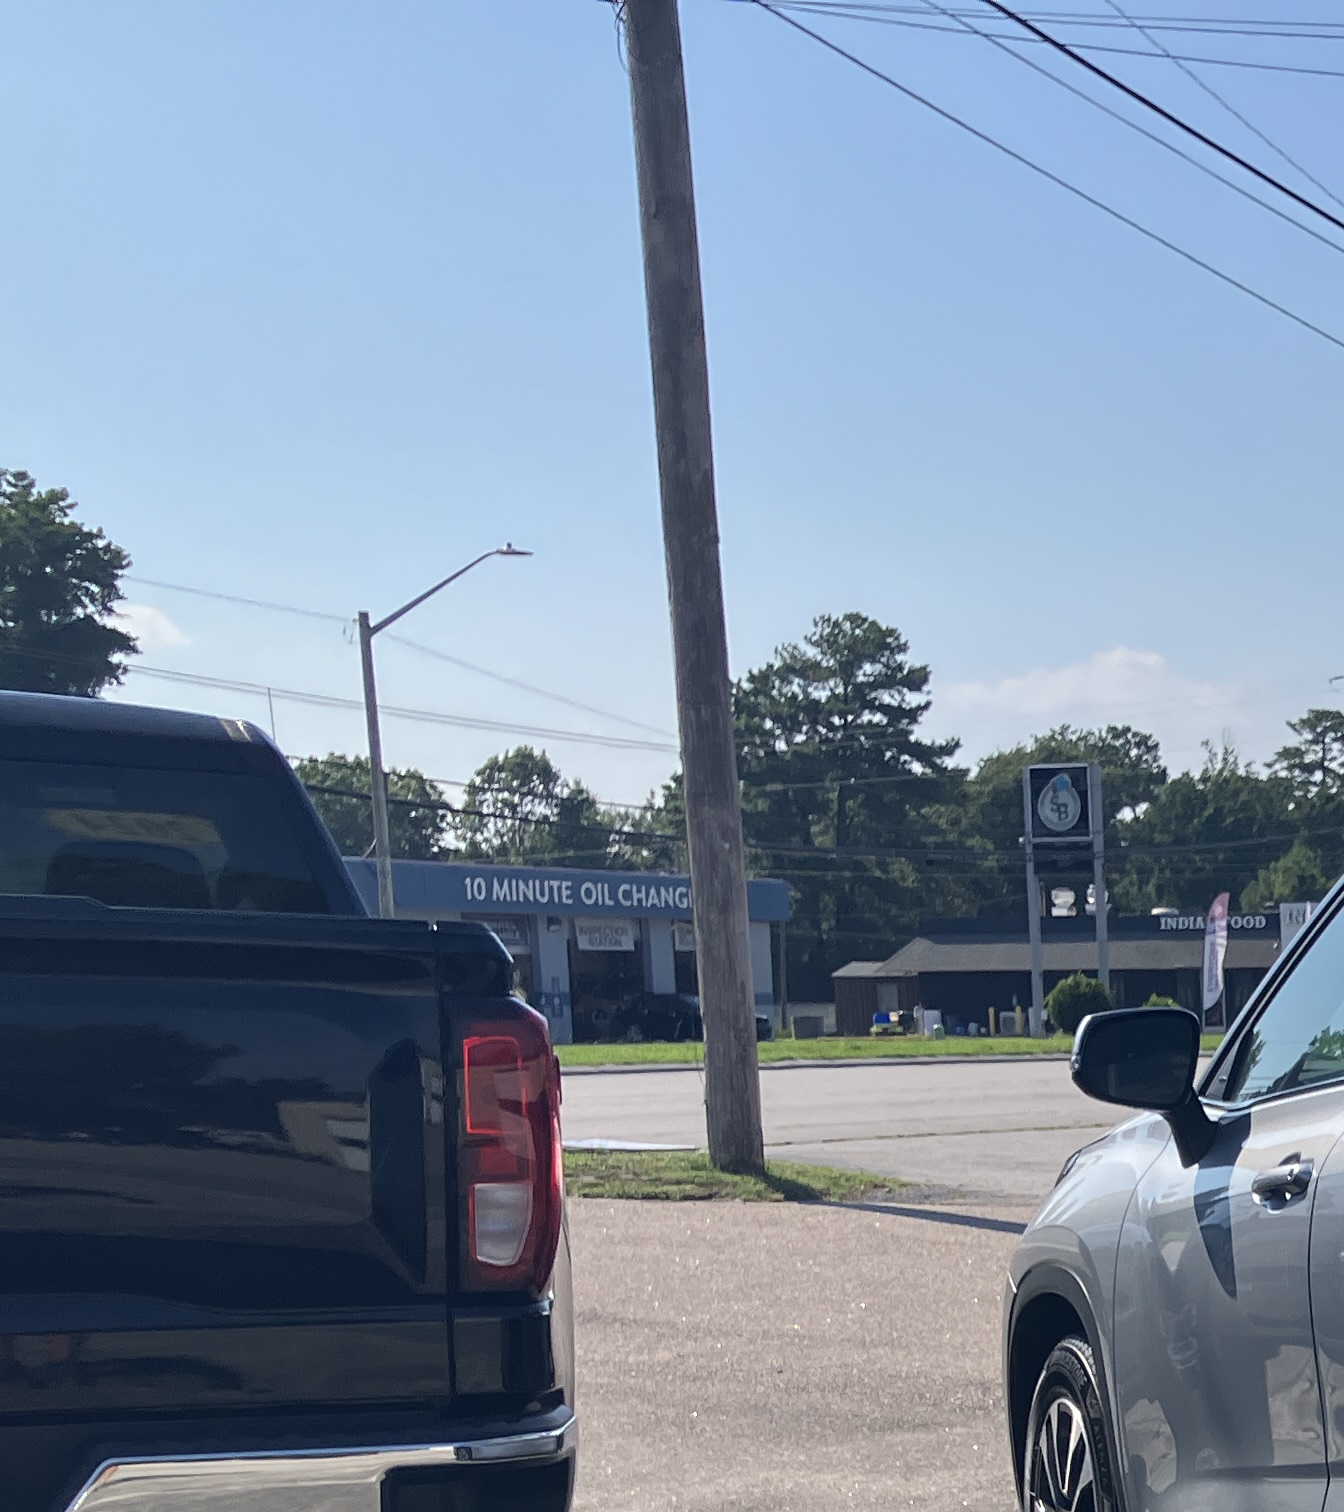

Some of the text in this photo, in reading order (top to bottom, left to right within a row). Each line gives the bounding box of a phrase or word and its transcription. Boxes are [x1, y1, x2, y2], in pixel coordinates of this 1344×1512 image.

[464, 876, 486, 901] 10
[492, 877, 573, 904] MINUTE
[580, 882, 614, 906] OIL
[1160, 917, 1205, 930] INDIA
